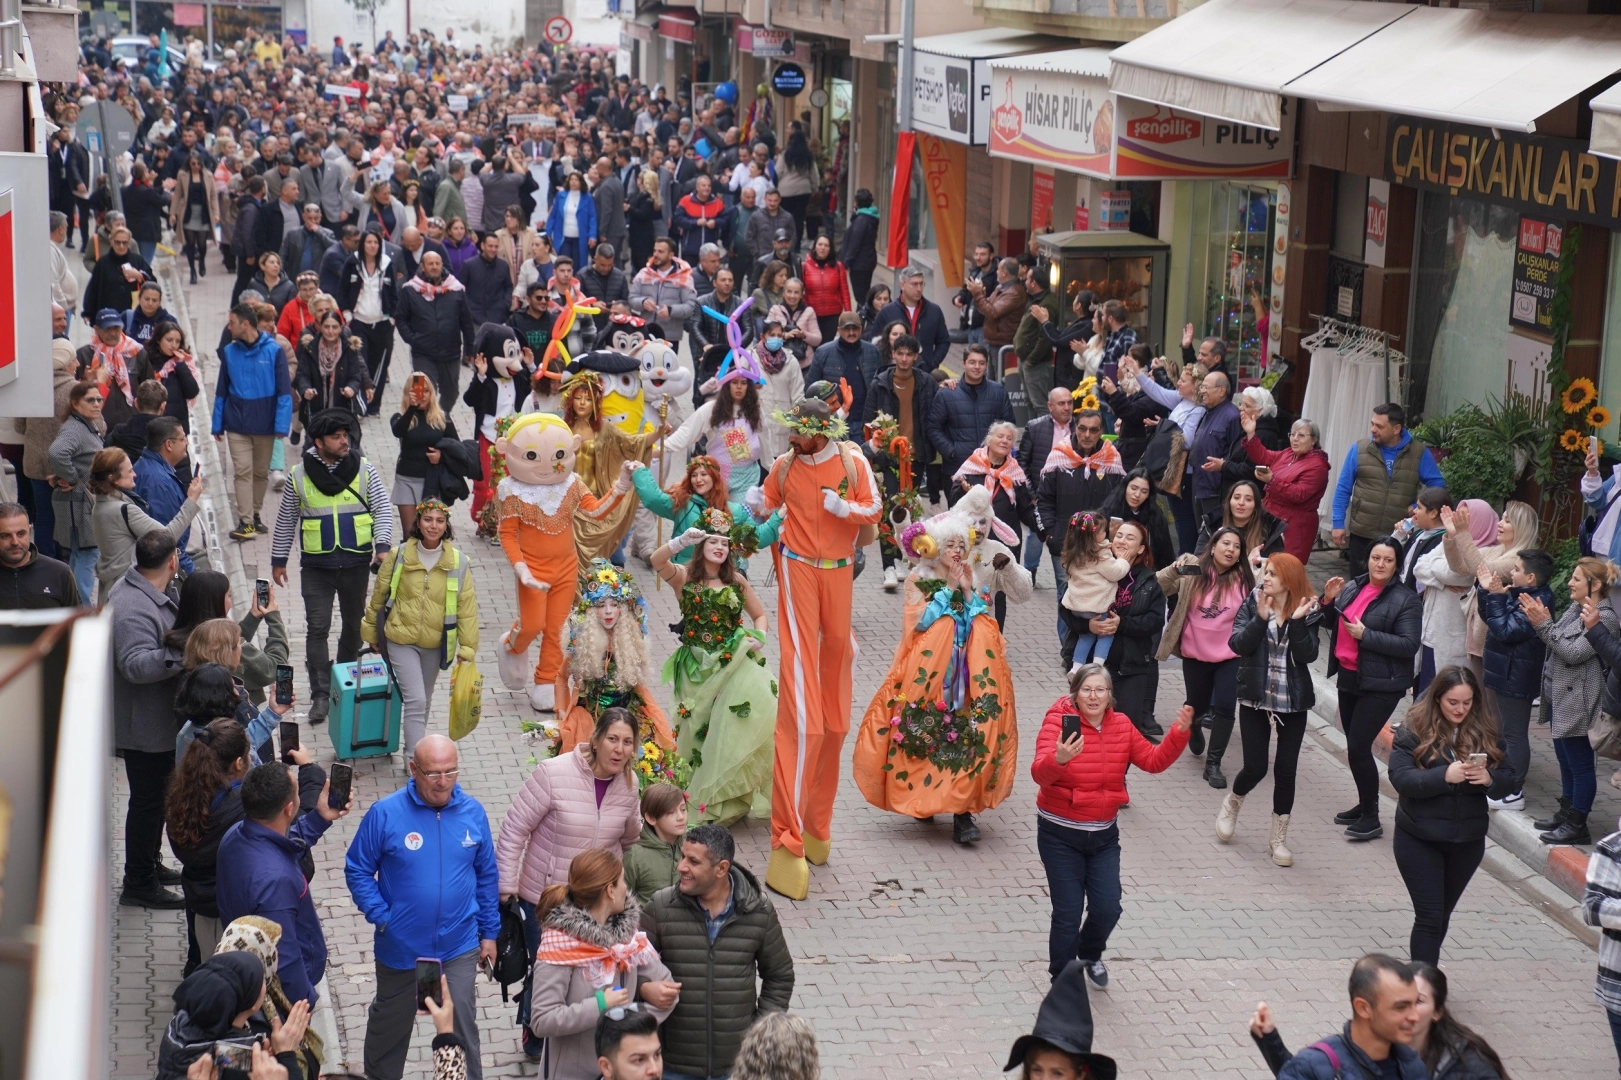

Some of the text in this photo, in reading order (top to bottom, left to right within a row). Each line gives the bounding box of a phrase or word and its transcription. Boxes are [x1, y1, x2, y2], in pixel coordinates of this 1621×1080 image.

[914, 77, 944, 104] PETSHOP
[1024, 83, 1093, 144] HİSAR PİLİÇ
[1133, 119, 1193, 138] şenpiliç
[1391, 125, 1600, 214] ÇALIŞKANLAR
[1517, 252, 1560, 273] ÇALIŞKANLAR
[1526, 267, 1548, 283] PERDE
[1520, 281, 1532, 294] 0507
